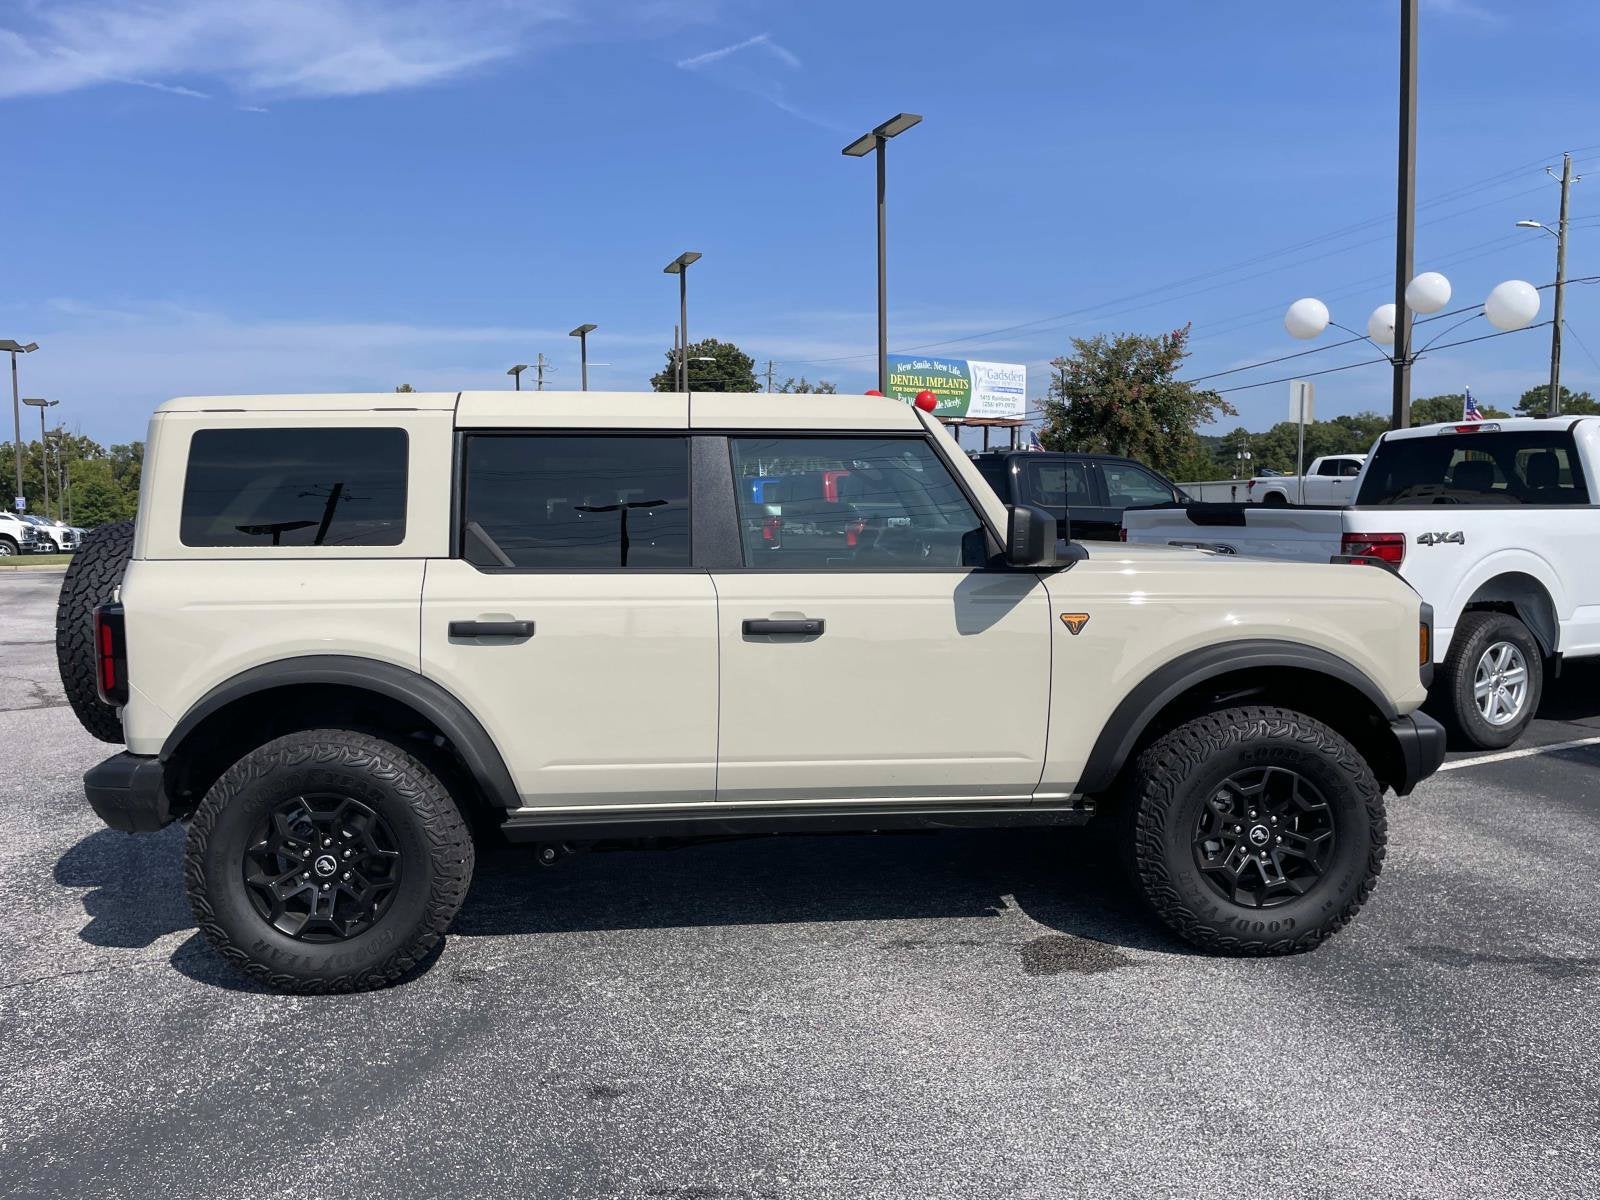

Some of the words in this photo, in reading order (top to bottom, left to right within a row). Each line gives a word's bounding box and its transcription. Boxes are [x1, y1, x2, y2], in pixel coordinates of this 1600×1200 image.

[897, 363, 912, 373] New
[934, 361, 948, 371] New
[890, 373, 924, 387] DENTAL
[926, 376, 969, 390] IMPLANTS
[987, 368, 1024, 383] Gadsden
[1177, 871, 1296, 933] GOODYEAR
